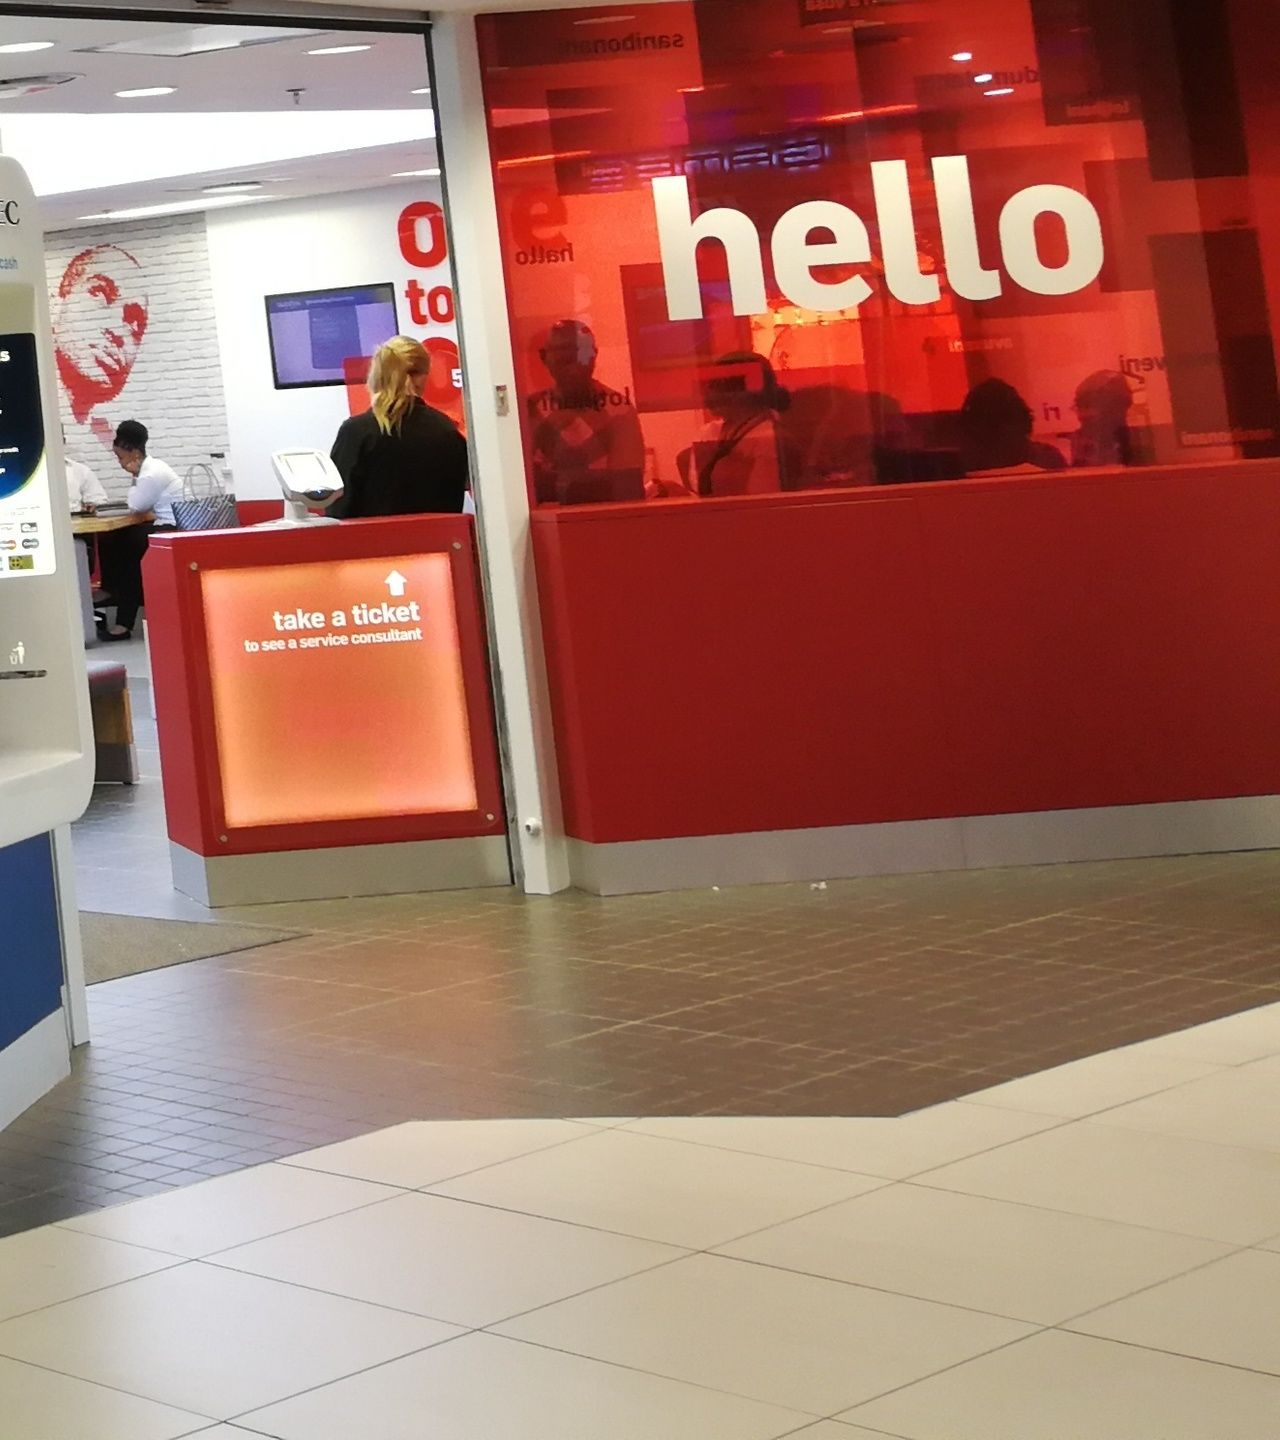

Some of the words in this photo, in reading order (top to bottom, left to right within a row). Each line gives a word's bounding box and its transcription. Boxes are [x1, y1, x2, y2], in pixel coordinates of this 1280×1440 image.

[651, 153, 1105, 322] hello
[405, 279, 455, 325] to
[273, 608, 325, 631] take
[332, 610, 346, 627] a
[351, 601, 420, 625] ticket
[244, 640, 259, 653] to
[262, 638, 286, 651] see
[288, 638, 297, 650] a
[300, 634, 349, 648] service
[351, 628, 423, 645] consultant
